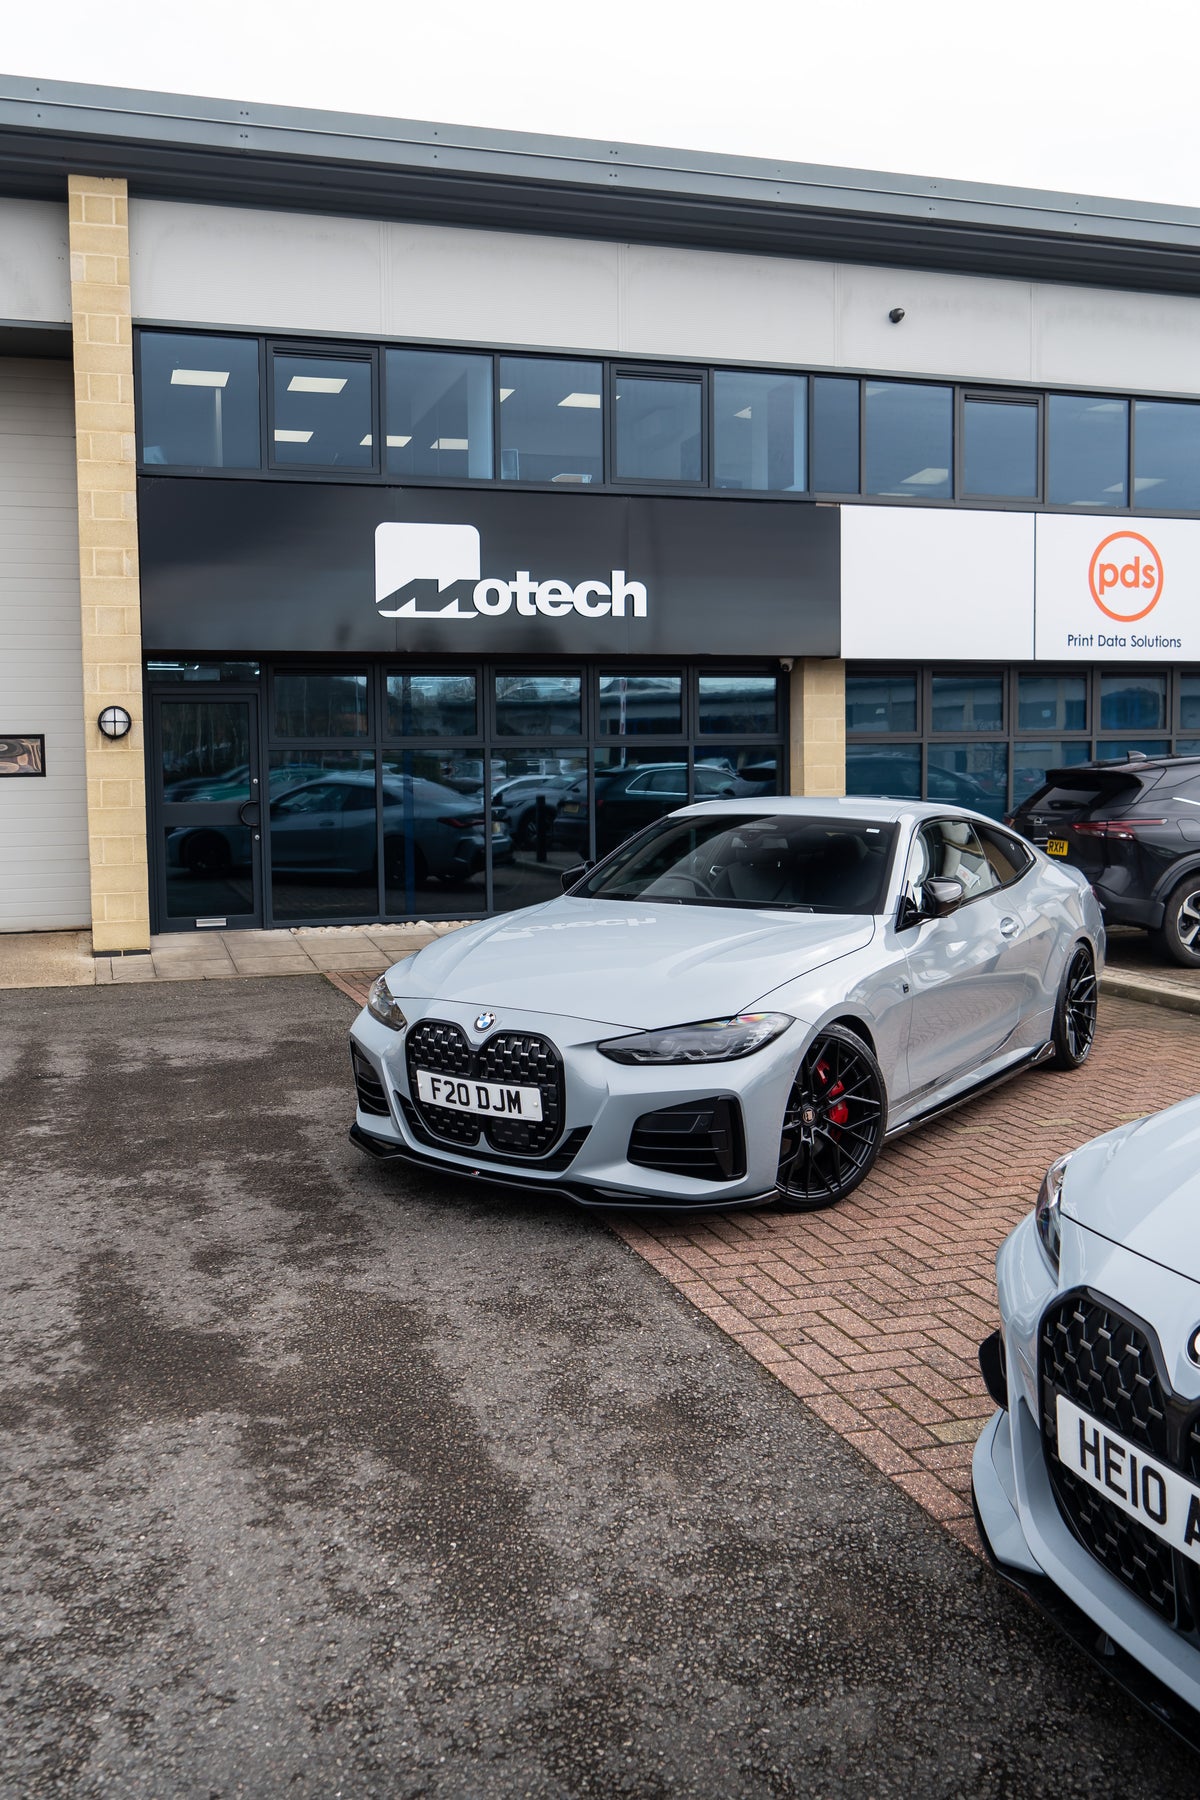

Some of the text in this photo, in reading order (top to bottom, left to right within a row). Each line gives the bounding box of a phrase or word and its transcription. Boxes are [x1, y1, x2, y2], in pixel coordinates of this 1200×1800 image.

[1098, 555, 1156, 596] pds
[1067, 633, 1182, 648] Print Data Solutions
[430, 1076, 523, 1115] F20 DJM
